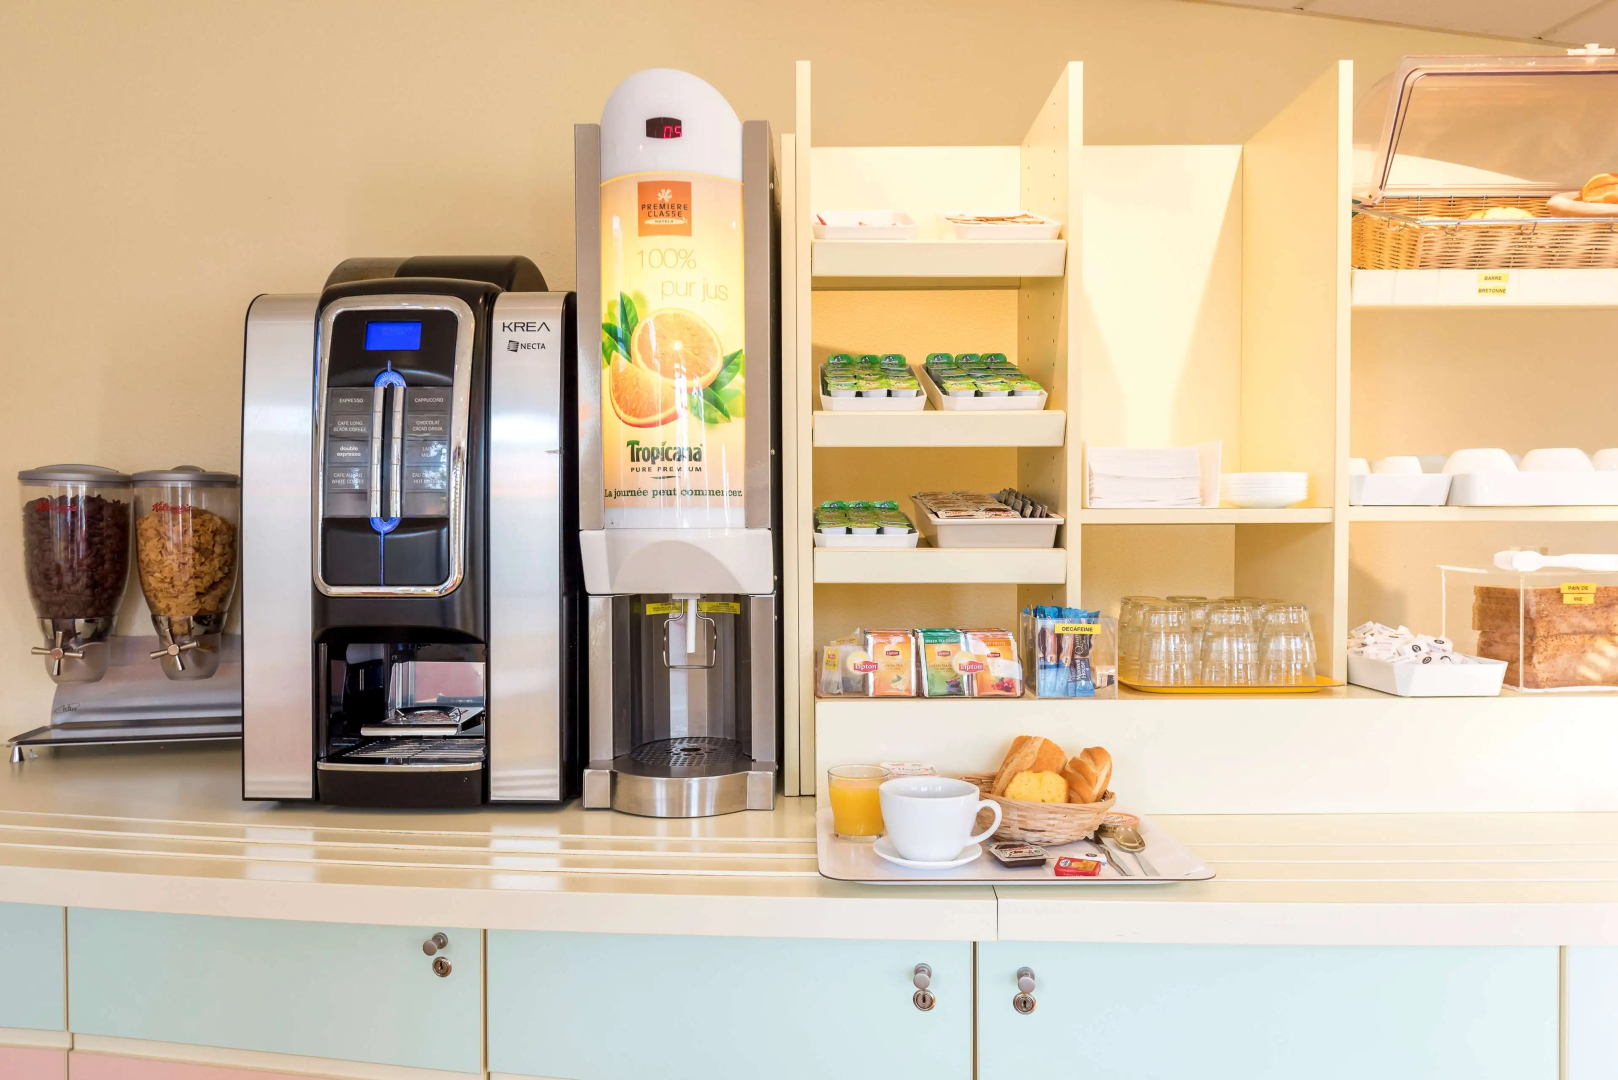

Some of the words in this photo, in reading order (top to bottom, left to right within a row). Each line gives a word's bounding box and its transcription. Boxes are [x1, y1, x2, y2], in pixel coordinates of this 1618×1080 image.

[641, 203, 688, 211] PREMIERE
[647, 210, 683, 218] CLASSE
[637, 248, 697, 270] 100%
[661, 280, 696, 300] pur
[702, 278, 728, 302] jus
[502, 321, 551, 333] KREA
[520, 342, 546, 350] NECTA
[626, 439, 703, 465] Tropicana
[604, 489, 613, 498] La
[614, 487, 649, 499] journée
[652, 487, 677, 498] peut
[855, 662, 877, 671] Lipton
[960, 663, 982, 672] Lipton
